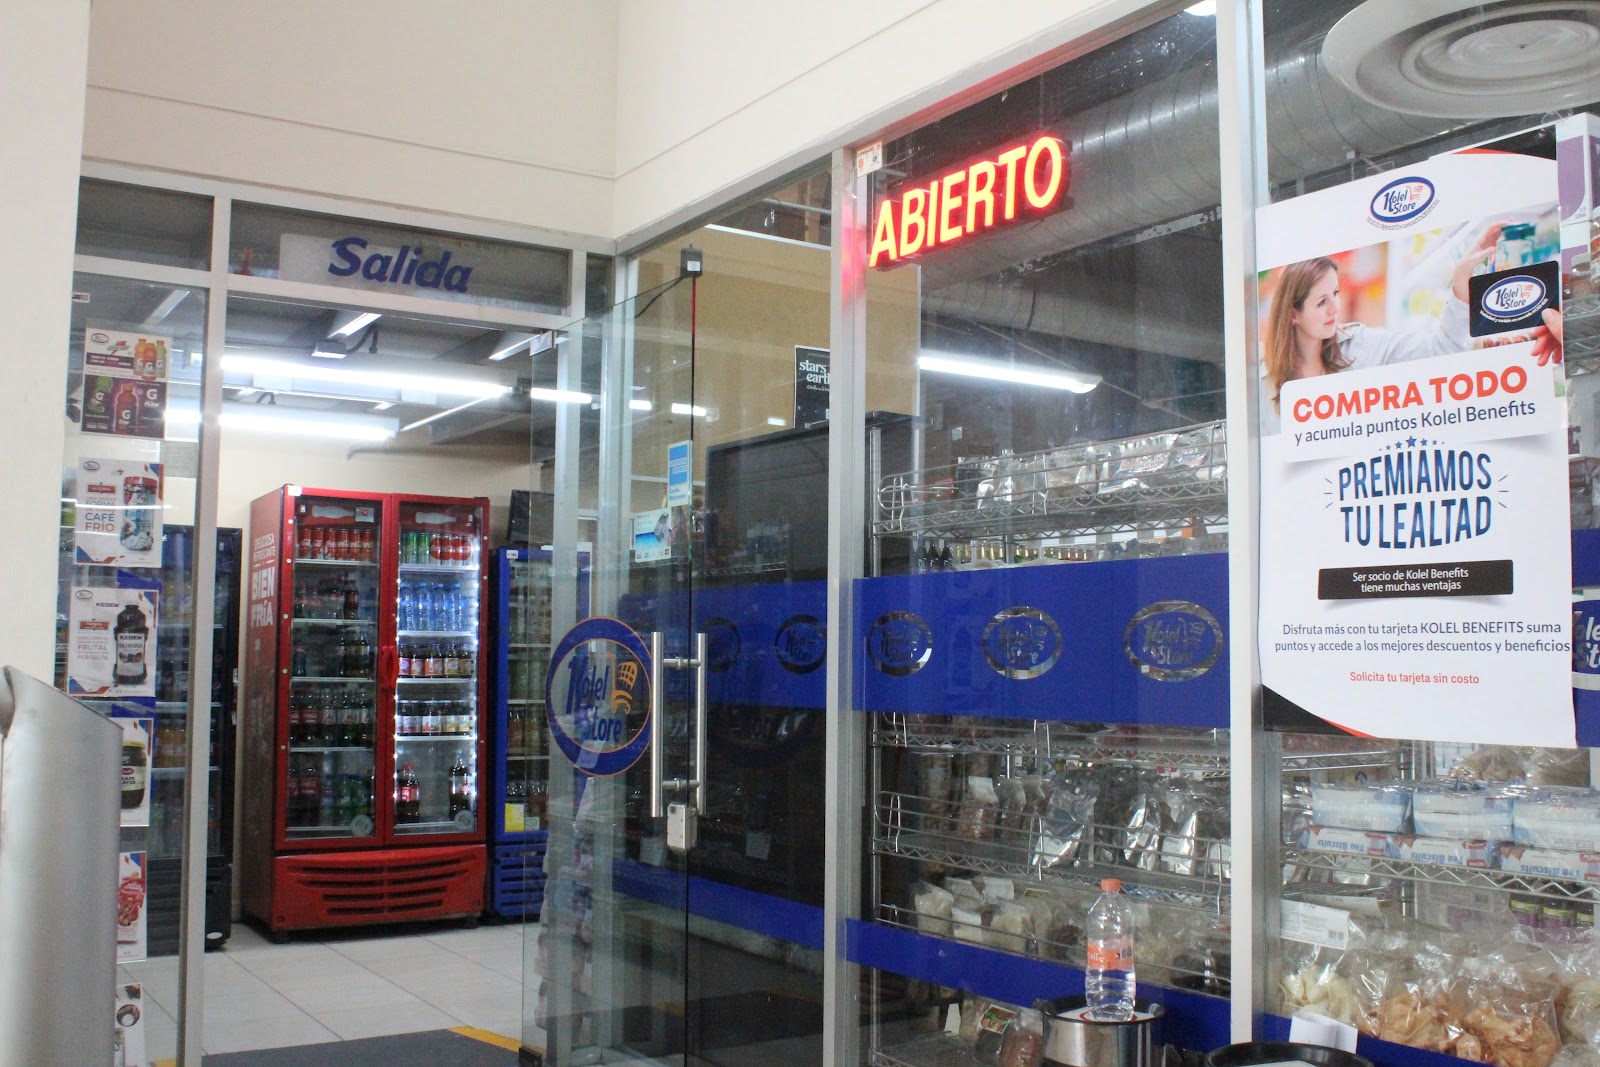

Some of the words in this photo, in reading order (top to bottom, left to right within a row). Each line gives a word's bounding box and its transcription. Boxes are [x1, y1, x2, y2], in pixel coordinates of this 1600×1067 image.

[868, 136, 1062, 267] ABIERTO
[1384, 189, 1408, 212] Kolel
[1393, 202, 1416, 214] Store
[328, 237, 473, 293] Salida
[1495, 287, 1519, 307] Kolel
[1504, 299, 1527, 309] Store
[799, 360, 827, 373] stars
[146, 389, 158, 400] G
[1293, 382, 1424, 423] COMPRA
[1429, 365, 1527, 404] TODO
[122, 410, 131, 419] G
[1295, 433, 1303, 446] y
[1305, 421, 1363, 442] acumula
[1366, 417, 1417, 438] puntos
[1421, 407, 1461, 428] Kolel
[1466, 400, 1536, 422] Benefits
[1338, 449, 1492, 501] PREMIAMOS
[85, 510, 115, 521] CAFÉ
[1340, 505, 1371, 547] TU
[1379, 496, 1492, 549] LEALTAD
[85, 522, 115, 532] FRÍO
[1352, 572, 1367, 582] Ser
[1368, 571, 1391, 581] socio
[1392, 570, 1404, 580] de
[1406, 568, 1429, 580] Kolel
[1430, 567, 1469, 579] Benefits
[252, 566, 275, 601] BIEN
[1361, 583, 1384, 593] tiene
[1385, 581, 1420, 592] muchas
[1422, 580, 1462, 592] ventajas
[1283, 624, 1323, 635] Disfruta
[1324, 624, 1345, 635] más
[1347, 625, 1366, 635] con
[1368, 624, 1379, 634] tu
[1381, 623, 1418, 636] tarjeta
[1420, 622, 1460, 634] KOLEL
[1462, 621, 1524, 634] BENEFITS
[1526, 623, 1561, 633] suma
[1275, 641, 1309, 653] puntos
[1310, 642, 1316, 652] y
[1318, 640, 1353, 651] accede
[1355, 642, 1362, 651] a
[1364, 640, 1379, 651] los
[1381, 640, 1424, 653] mejores
[1426, 640, 1492, 652] descuentos
[1495, 642, 1502, 653] y
[1505, 639, 1571, 652] beneficios
[566, 655, 610, 715] Kolel
[1350, 671, 1385, 682] Solicita
[1387, 673, 1397, 682] tu
[1399, 673, 1430, 685] tarjeta
[1433, 673, 1448, 683] sin
[1451, 674, 1480, 684] costo
[1317, 840, 1348, 850] Biscuits
[1411, 852, 1446, 864] Biscuits
[1521, 865, 1560, 877] Biscuits
